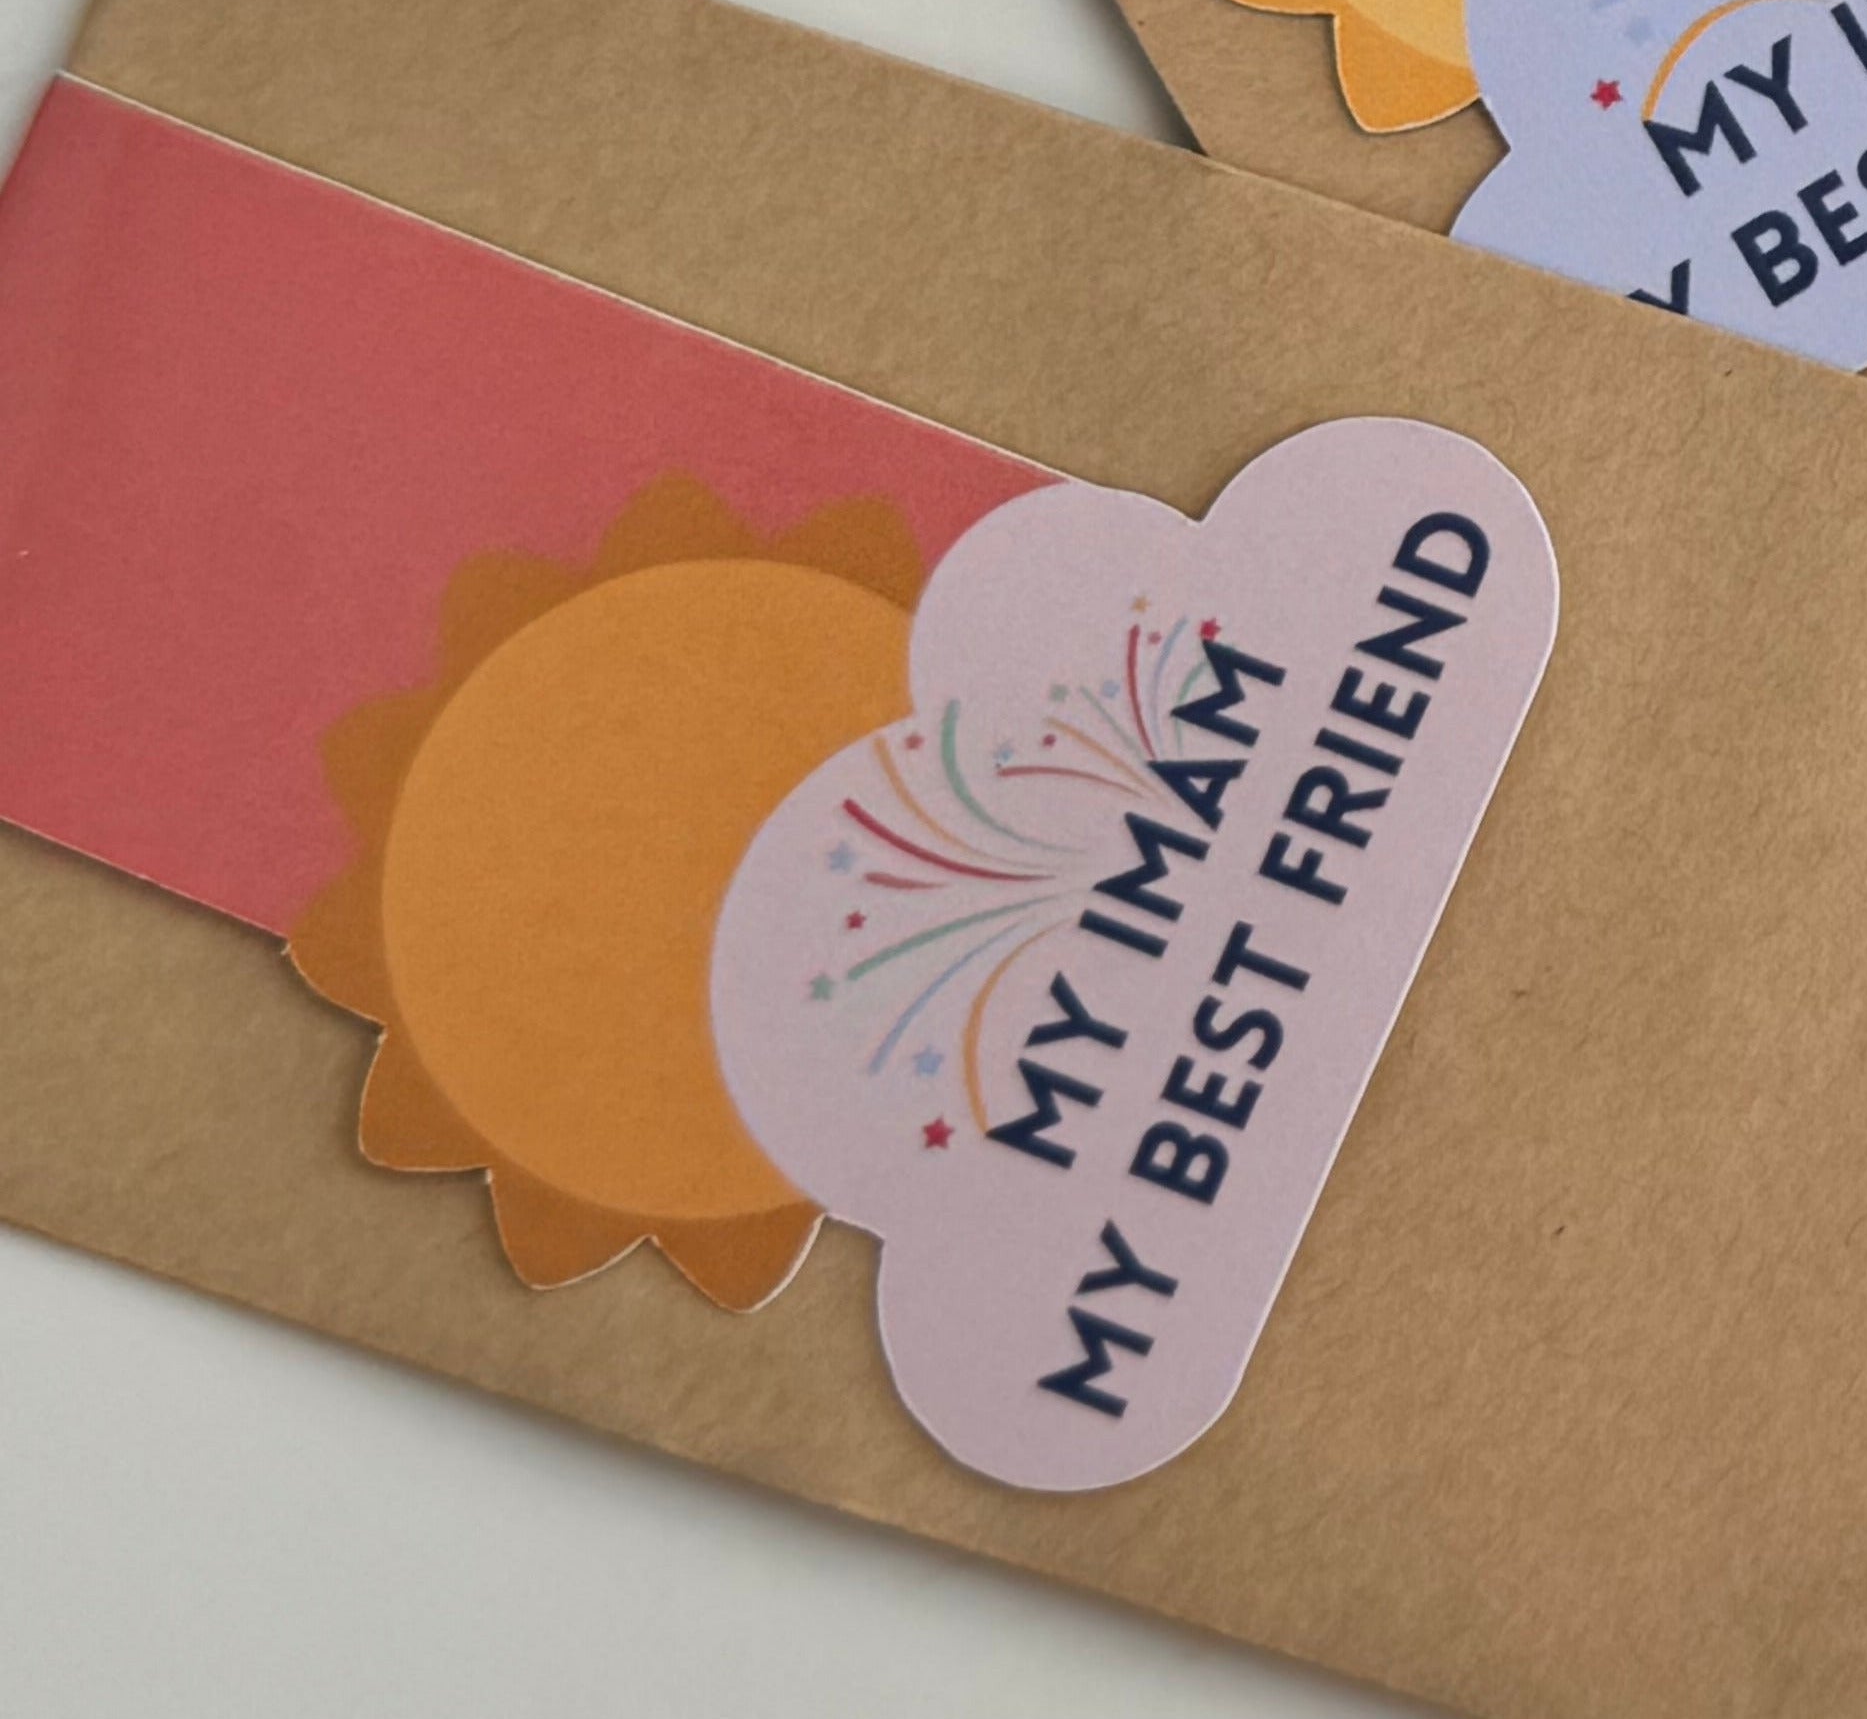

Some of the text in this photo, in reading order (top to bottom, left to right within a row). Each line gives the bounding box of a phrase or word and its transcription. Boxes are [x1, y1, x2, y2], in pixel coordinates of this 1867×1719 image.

[1643, 34, 1808, 197] MY
[988, 641, 1287, 1170] MY IMAM
[1038, 511, 1491, 1419] MY BEST FRIEND
